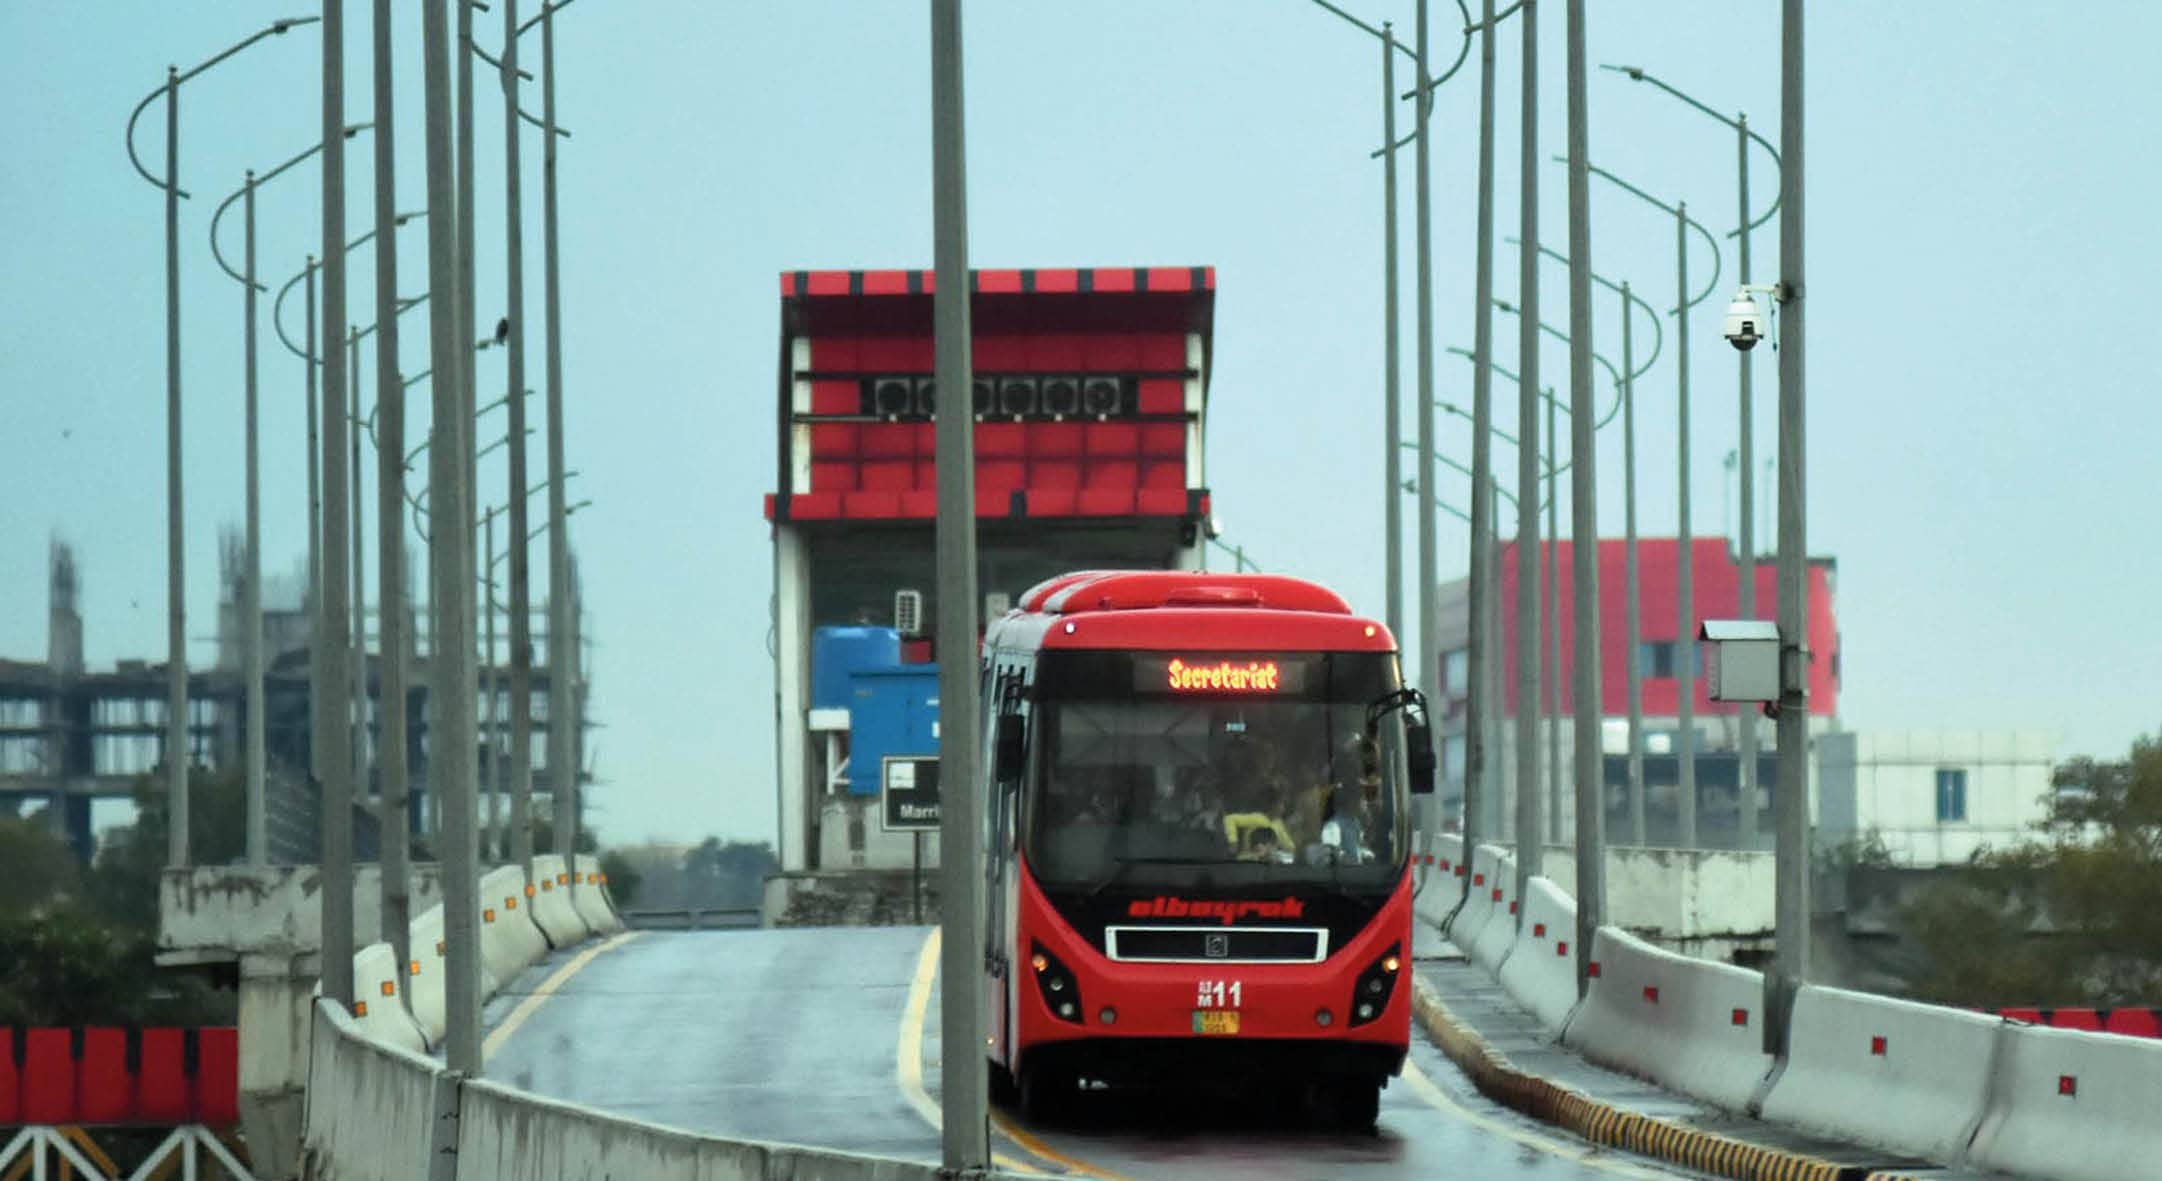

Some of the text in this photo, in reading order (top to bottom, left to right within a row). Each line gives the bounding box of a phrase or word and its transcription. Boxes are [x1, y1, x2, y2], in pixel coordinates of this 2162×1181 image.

[1167, 655, 1280, 690] Secretariat
[1128, 896, 1304, 926] albayrak
[1213, 979, 1242, 1008] 11
